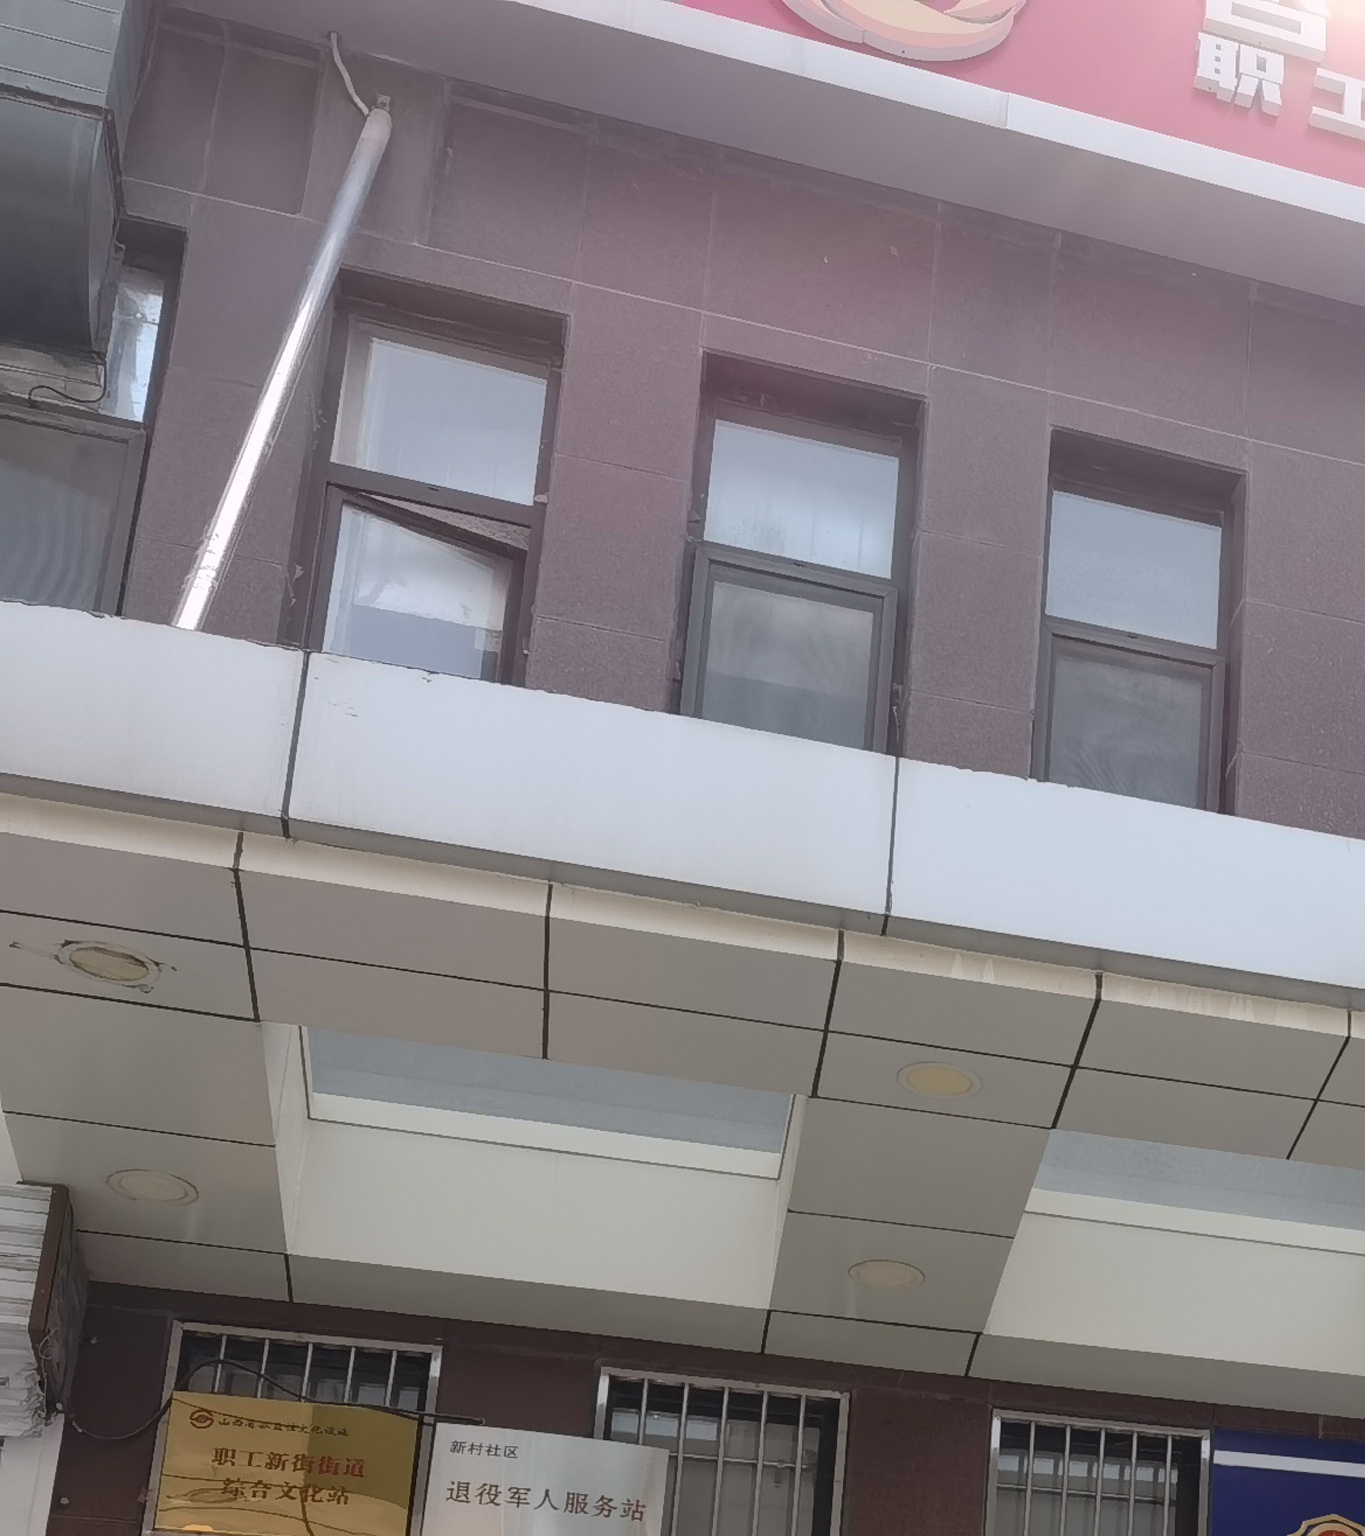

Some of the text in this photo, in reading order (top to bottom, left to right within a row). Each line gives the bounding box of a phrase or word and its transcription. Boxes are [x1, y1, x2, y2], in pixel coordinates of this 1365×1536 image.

[211, 1446, 366, 1479] 职工新街街道
[449, 1440, 519, 1459] 新村社区
[220, 1476, 350, 1506] 综合文化站
[445, 1480, 647, 1522] 退役军人服务站
